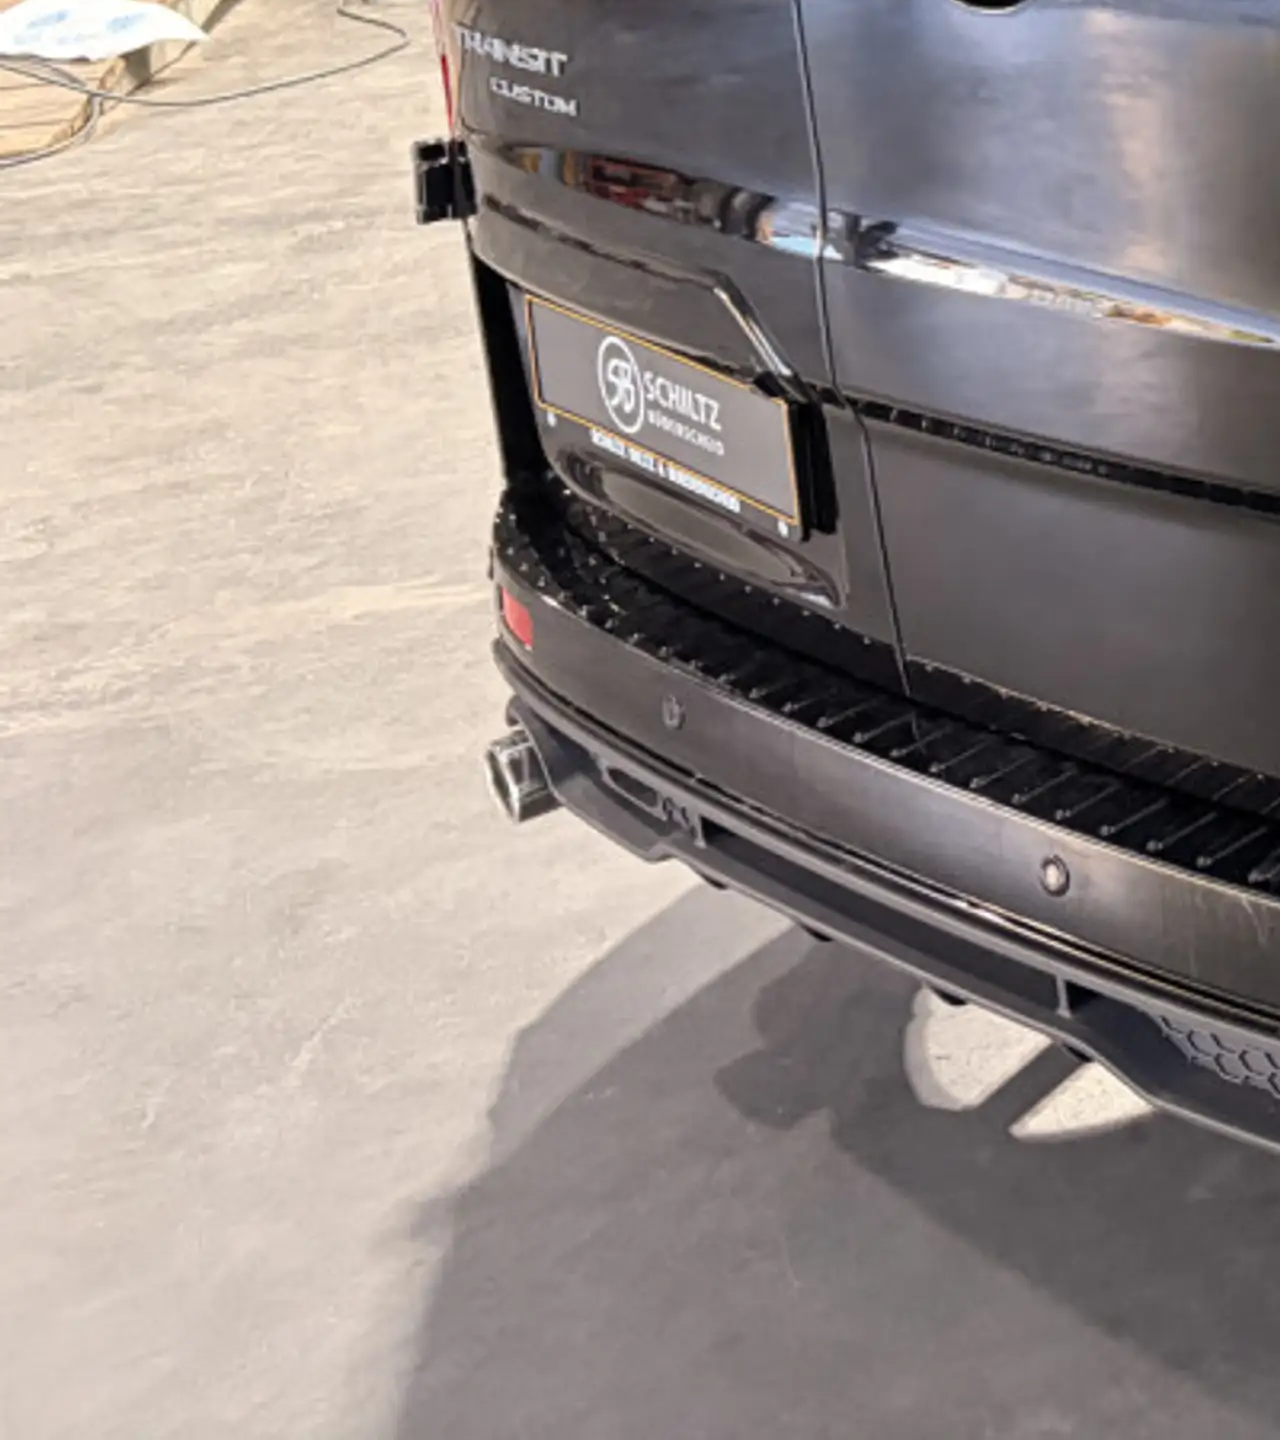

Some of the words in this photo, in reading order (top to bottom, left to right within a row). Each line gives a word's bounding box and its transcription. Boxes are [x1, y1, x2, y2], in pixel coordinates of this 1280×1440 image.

[454, 27, 568, 77] TRANSIT
[490, 77, 578, 117] CUSTOM
[643, 371, 722, 431] SCHILTZ
